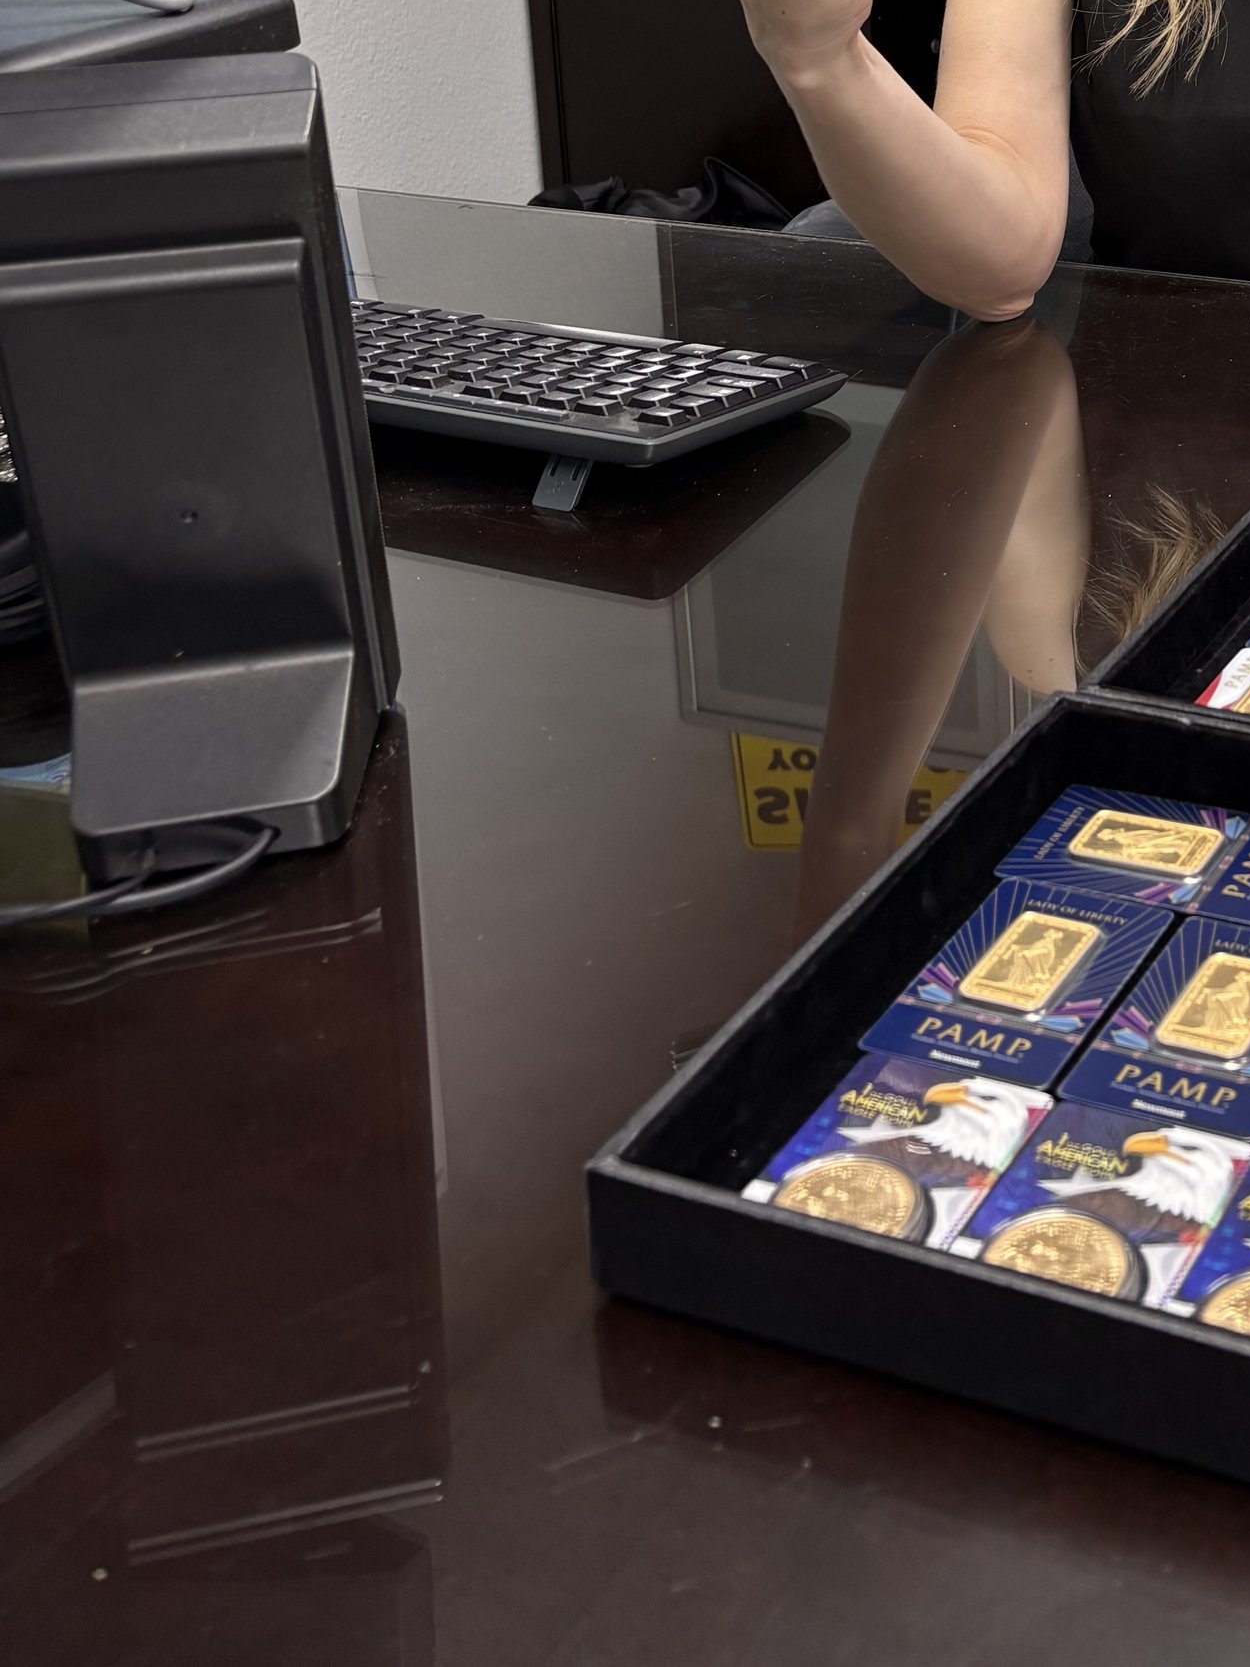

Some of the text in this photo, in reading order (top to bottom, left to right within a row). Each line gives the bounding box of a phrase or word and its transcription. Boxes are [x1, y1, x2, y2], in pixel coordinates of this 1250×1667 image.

[1028, 898, 1128, 926] LADY OF LIBERTY
[1214, 939, 1247, 953] LADY
[916, 1016, 1032, 1056] PAMP
[1114, 1064, 1237, 1107] PAMP
[840, 1090, 928, 1123] AMERICAN
[1037, 1140, 1128, 1174] AMERICAN
